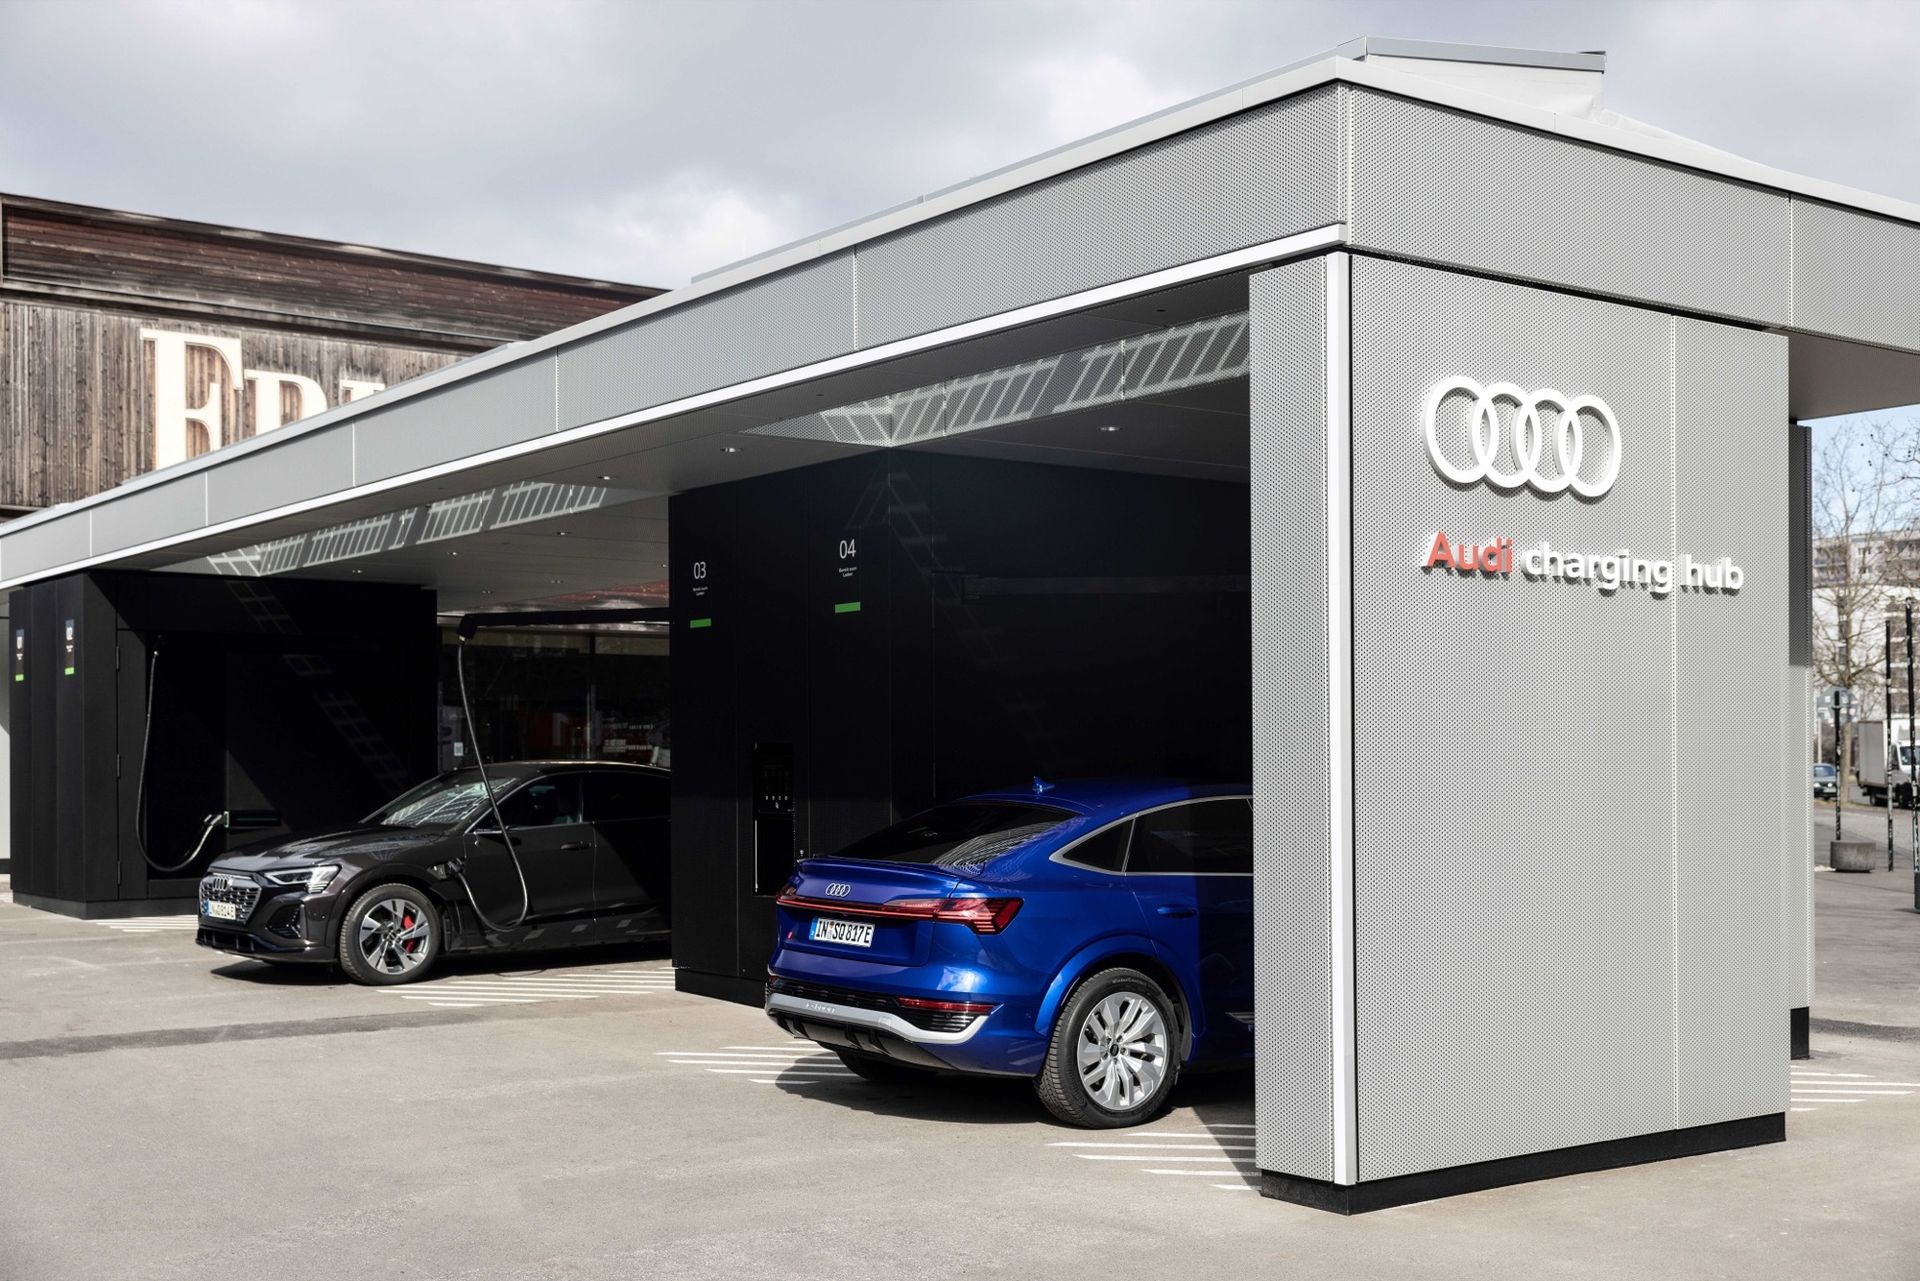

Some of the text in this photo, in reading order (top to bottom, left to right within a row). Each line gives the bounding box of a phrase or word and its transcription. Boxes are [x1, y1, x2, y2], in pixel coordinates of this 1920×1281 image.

[839, 539, 856, 559] 04
[693, 561, 707, 580] 03
[1422, 531, 1744, 594] Audi charging hub
[816, 920, 872, 944] IN SQ 817E
